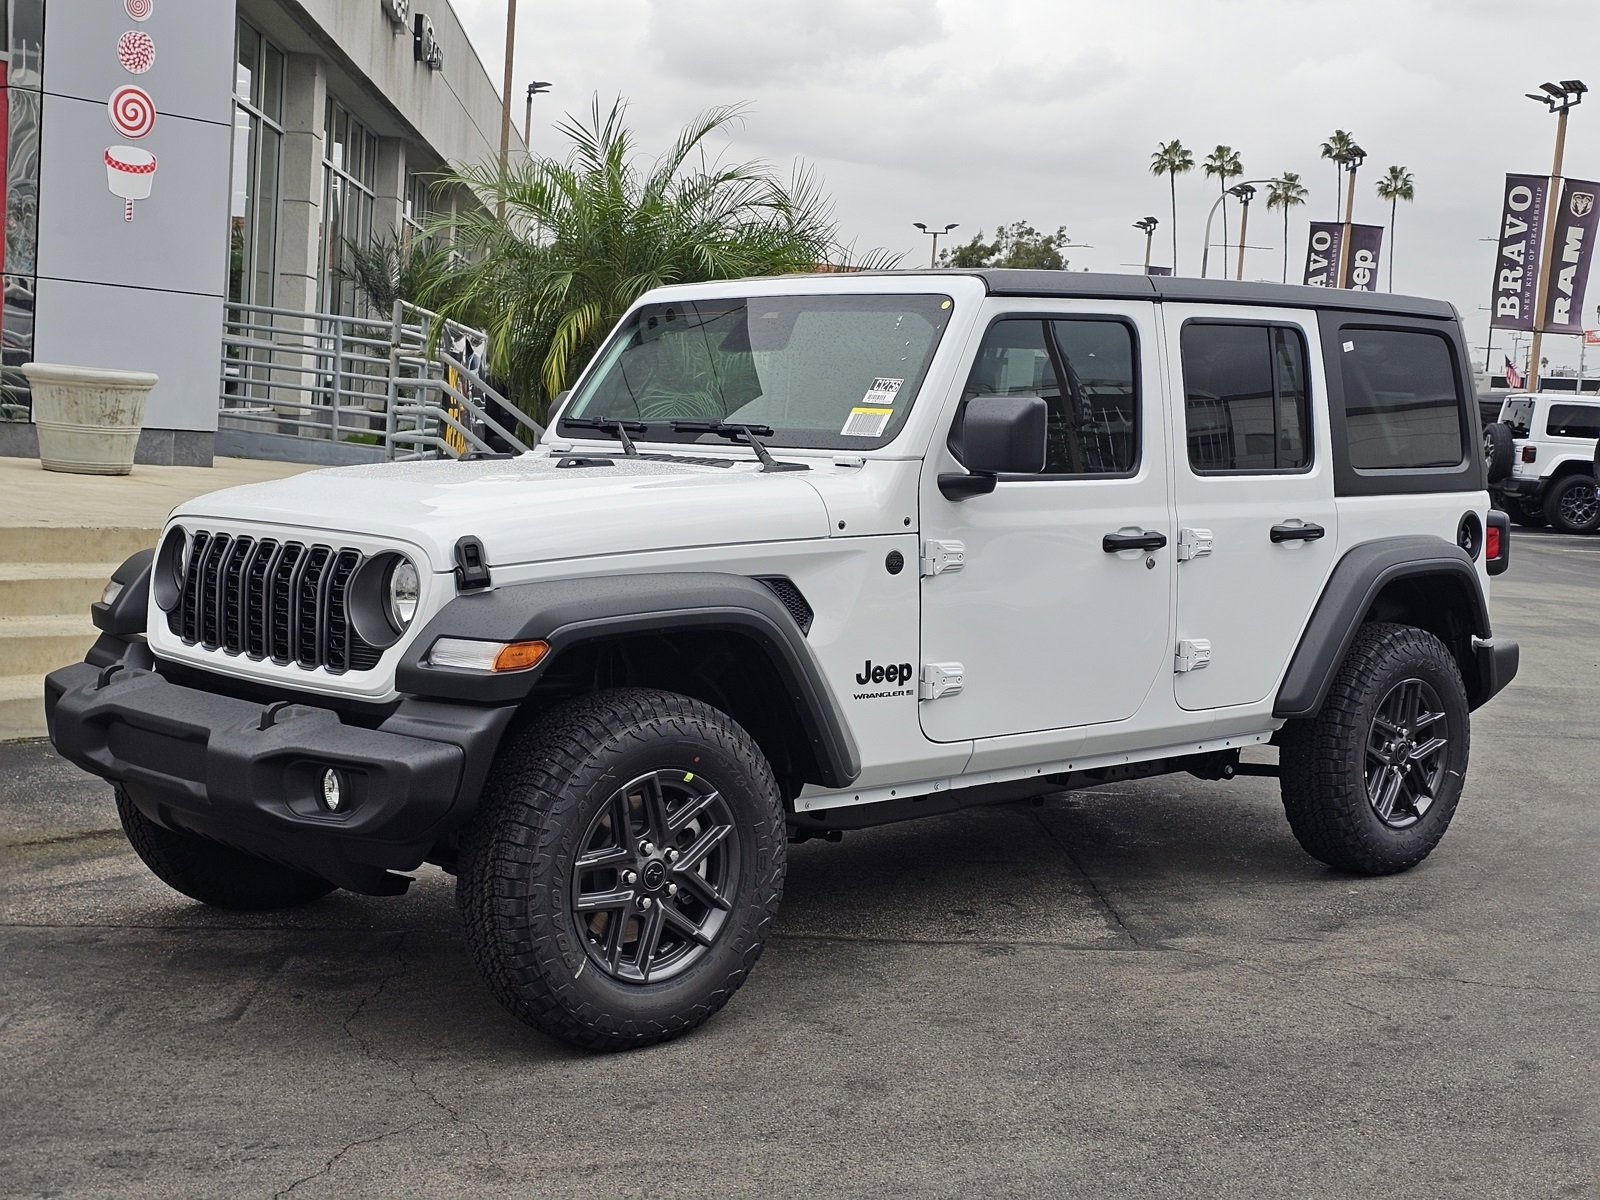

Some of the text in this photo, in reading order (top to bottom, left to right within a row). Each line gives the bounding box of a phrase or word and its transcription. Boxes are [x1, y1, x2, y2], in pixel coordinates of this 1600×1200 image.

[1530, 187, 1542, 245] DEALERSHIP
[1497, 185, 1532, 319] BRAVO
[1528, 248, 1535, 260] OF
[1552, 226, 1584, 325] RAM
[856, 660, 912, 686] Jeep
[853, 690, 904, 700] WRANGLER
